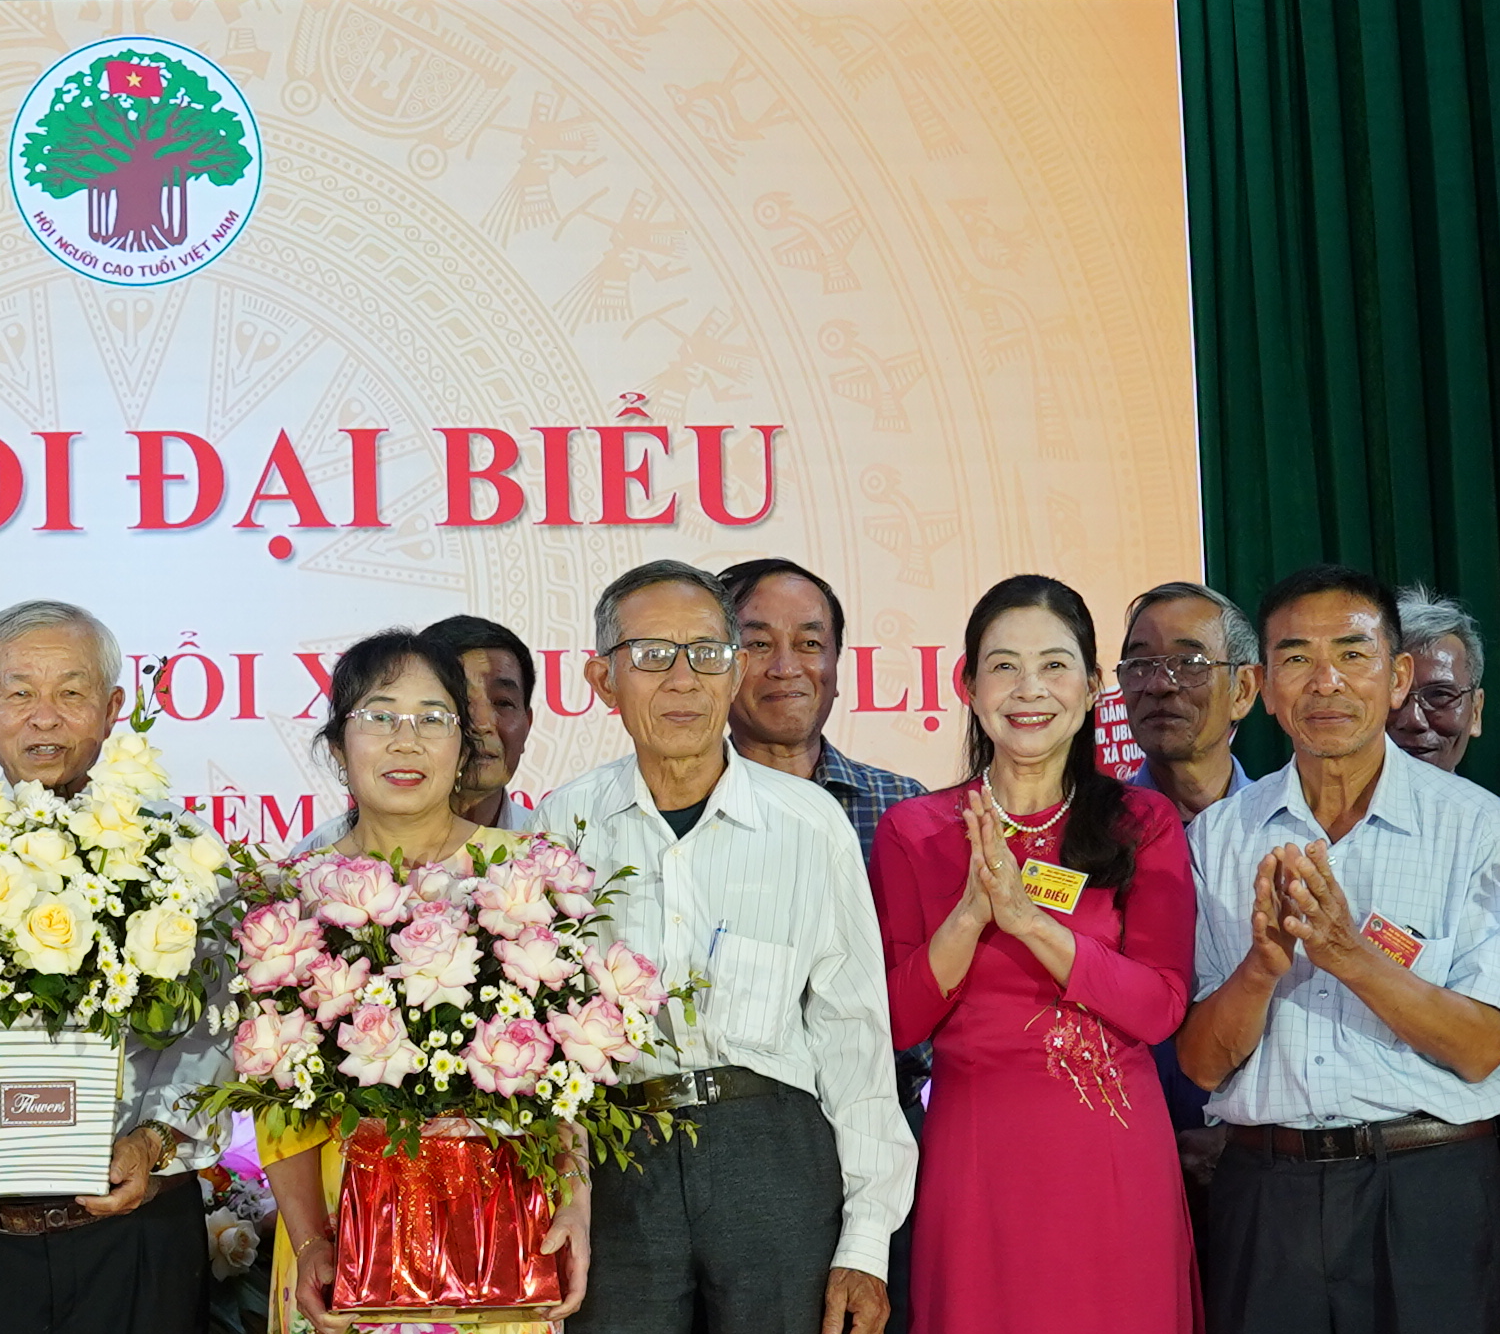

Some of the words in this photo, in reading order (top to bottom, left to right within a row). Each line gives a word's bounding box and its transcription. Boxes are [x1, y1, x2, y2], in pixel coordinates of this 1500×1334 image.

[33, 210, 56, 238] HỘI
[54, 236, 99, 270] NGƯỜI
[102, 261, 134, 278] CAO
[138, 255, 177, 278] TUỔI
[179, 241, 213, 267] VIỆT
[211, 209, 240, 244] NAM
[125, 427, 391, 560] ĐẠI
[432, 391, 784, 527] BIỂU
[1043, 887, 1070, 904] BIỂU
[10, 1092, 67, 1115] Flowers
